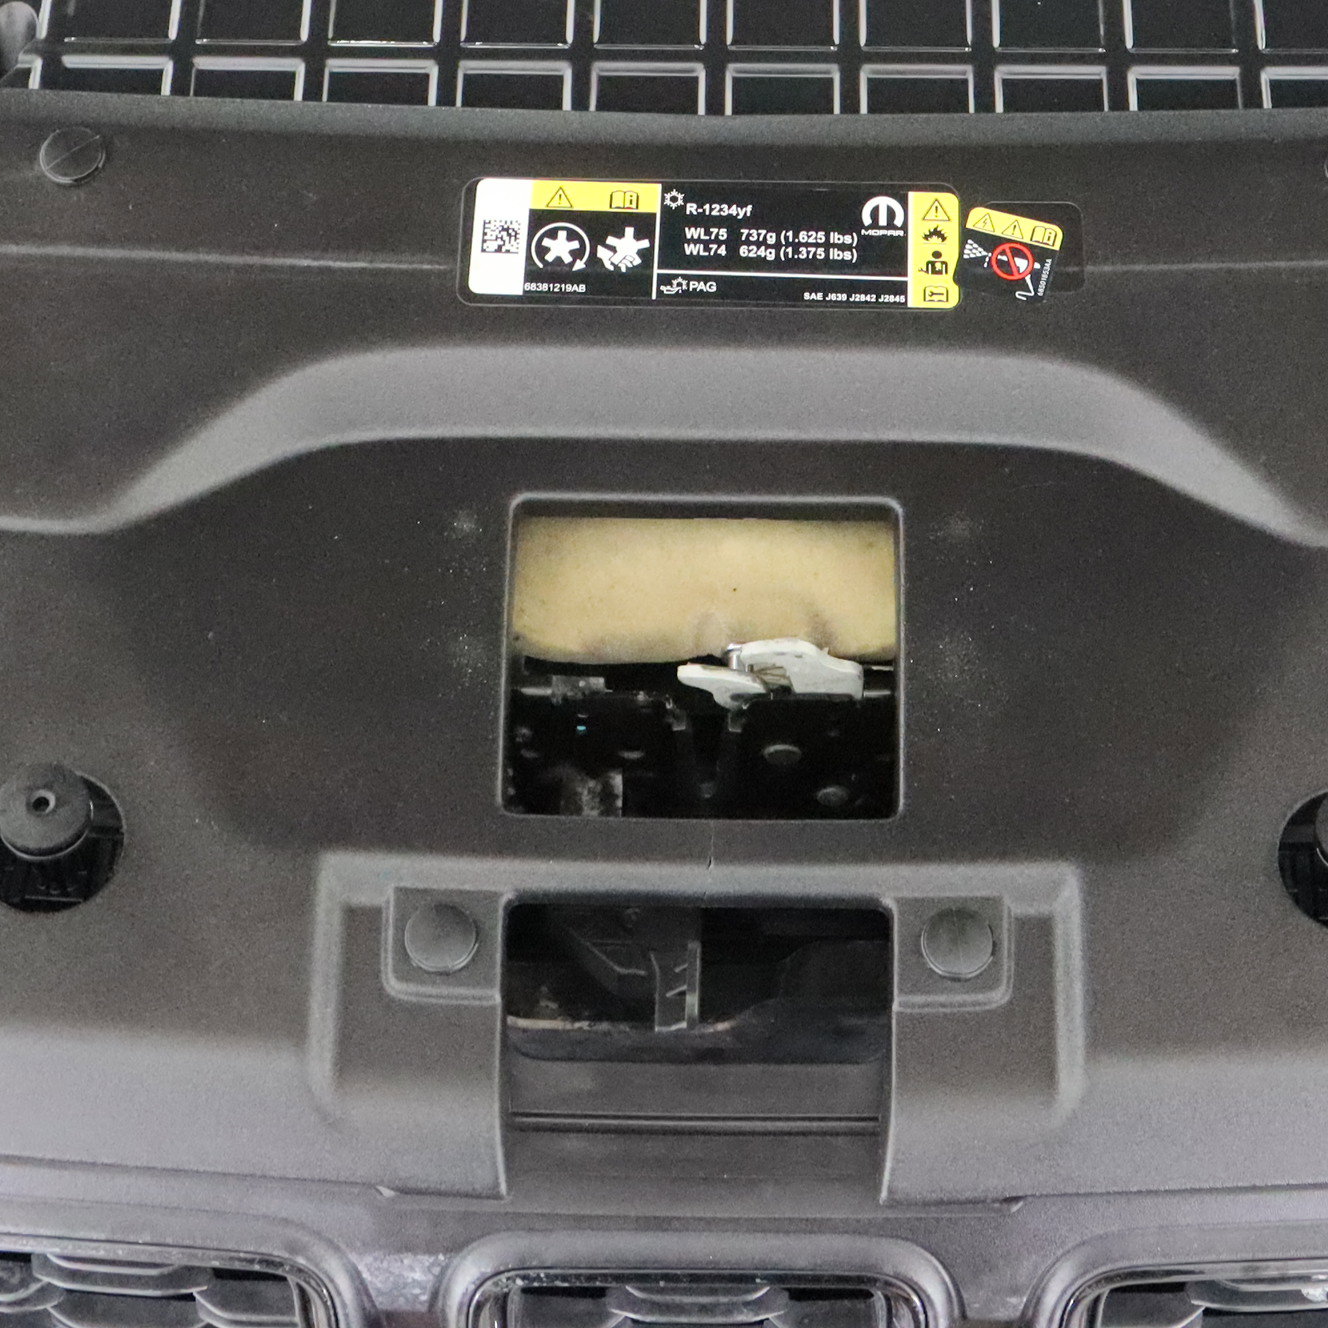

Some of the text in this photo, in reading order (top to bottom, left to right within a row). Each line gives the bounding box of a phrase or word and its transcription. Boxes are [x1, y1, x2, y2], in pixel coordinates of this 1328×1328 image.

[686, 203, 752, 219] R-1234yf
[685, 227, 857, 247] WL75 737g (1.625 lbs)
[684, 243, 857, 263] WL74 624g (1.375 lbs)
[689, 281, 716, 292] PAG
[804, 292, 823, 300] SAE
[826, 293, 847, 301] J639
